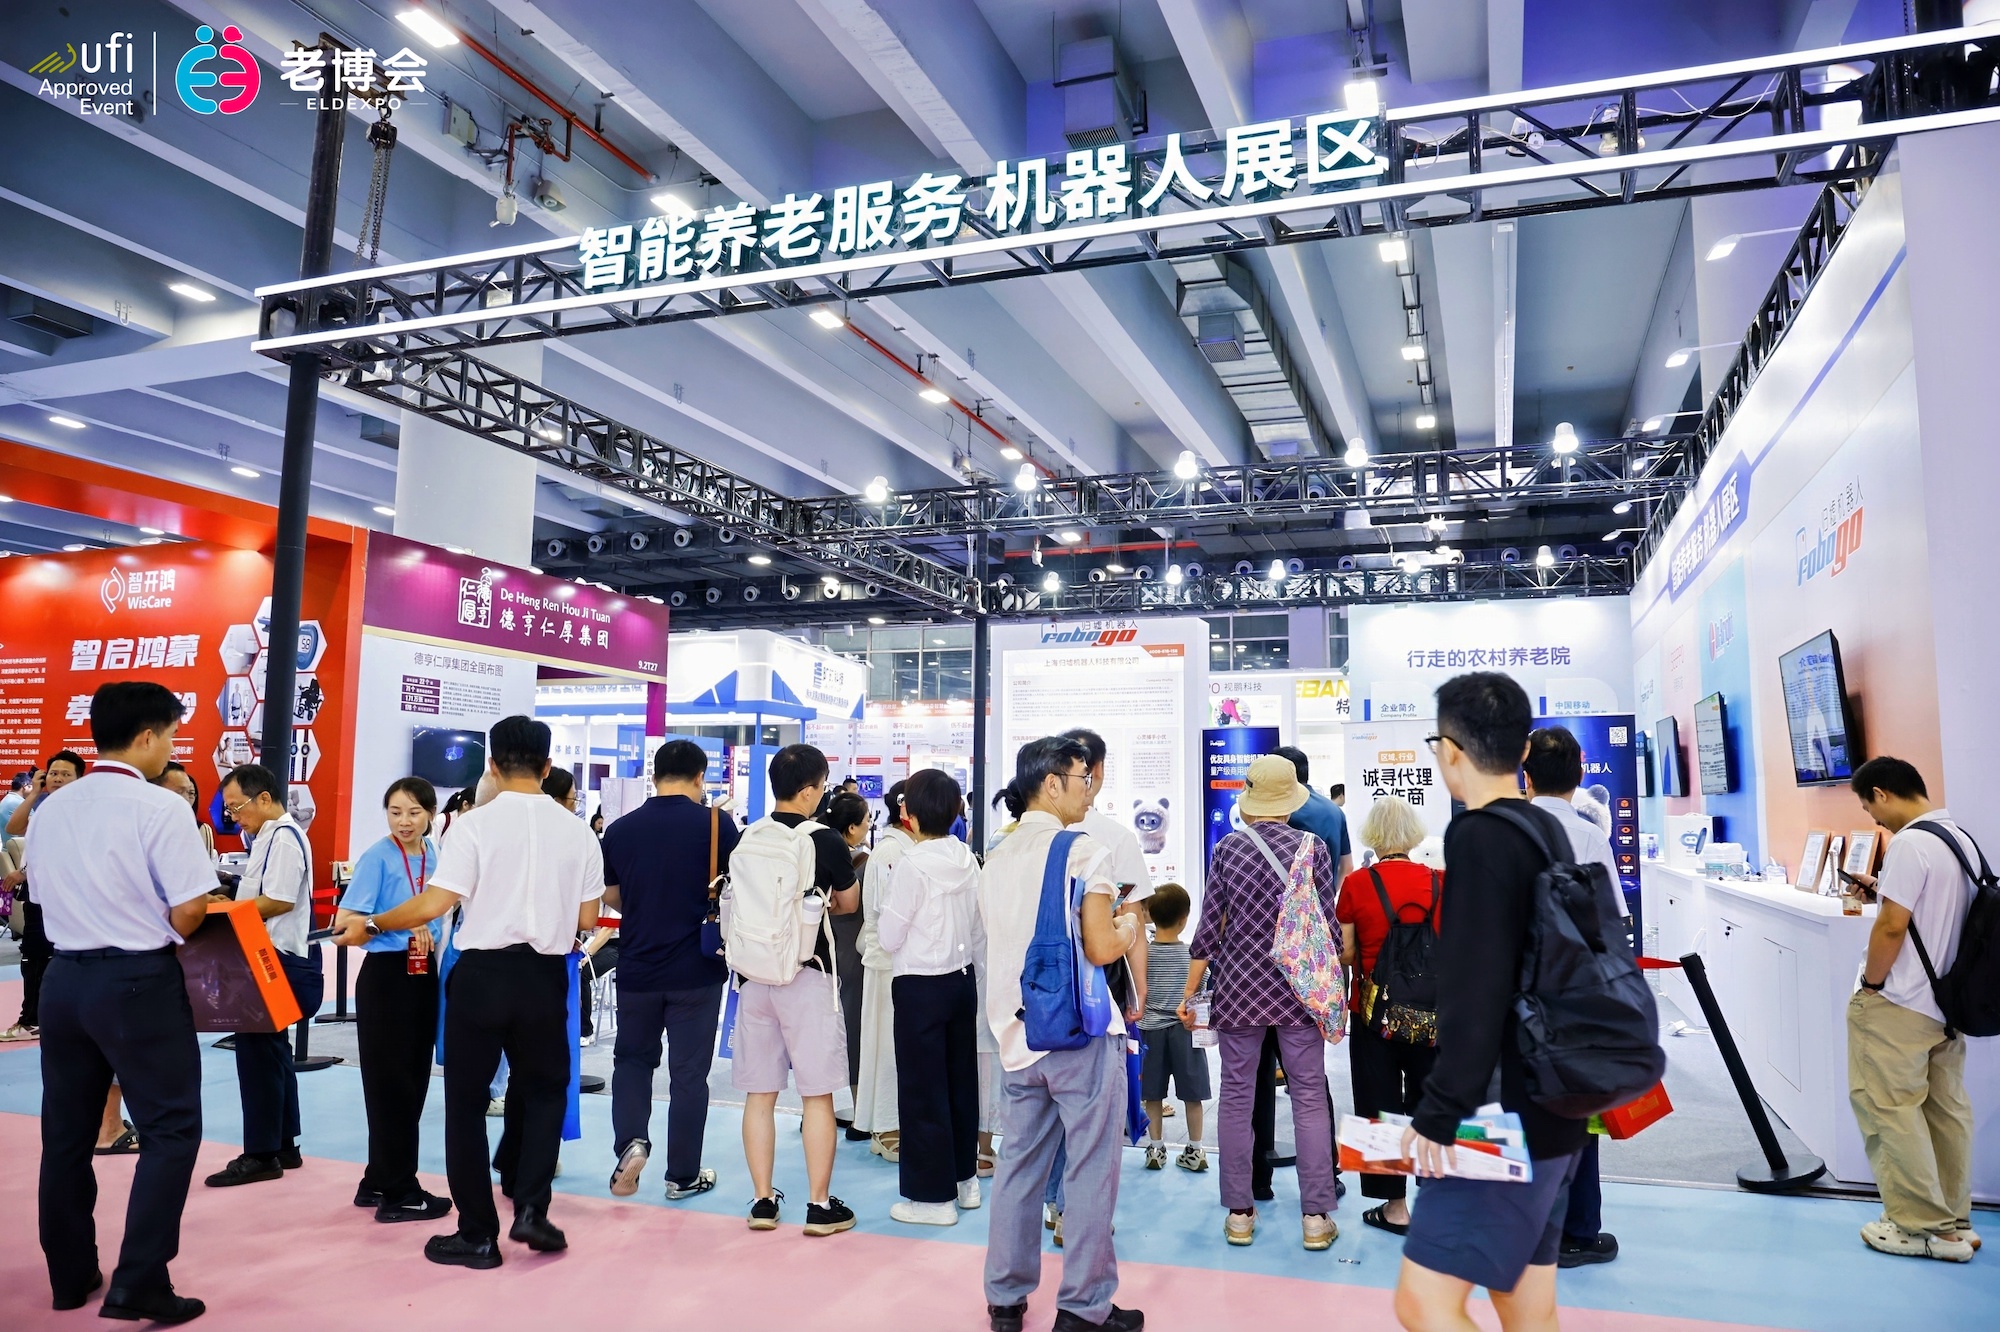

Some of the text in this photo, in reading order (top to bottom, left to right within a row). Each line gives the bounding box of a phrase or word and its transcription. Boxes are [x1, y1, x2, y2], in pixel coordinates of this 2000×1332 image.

[128, 568, 176, 594] 智开鸿
[127, 596, 172, 610] WisCare
[500, 588, 611, 624] De Heng Ren Hou Ji Tuan
[499, 607, 609, 650] 德亨仁厚集团
[69, 634, 201, 671] 智启鸿蒙
[1407, 646, 1571, 669] 行走的农村养老院
[1224, 682, 1263, 691] 视鹏科技
[1381, 703, 1416, 712] 企业简介
[1555, 701, 1590, 709] 中国移动
[1363, 768, 1433, 787] 诚寻代理
